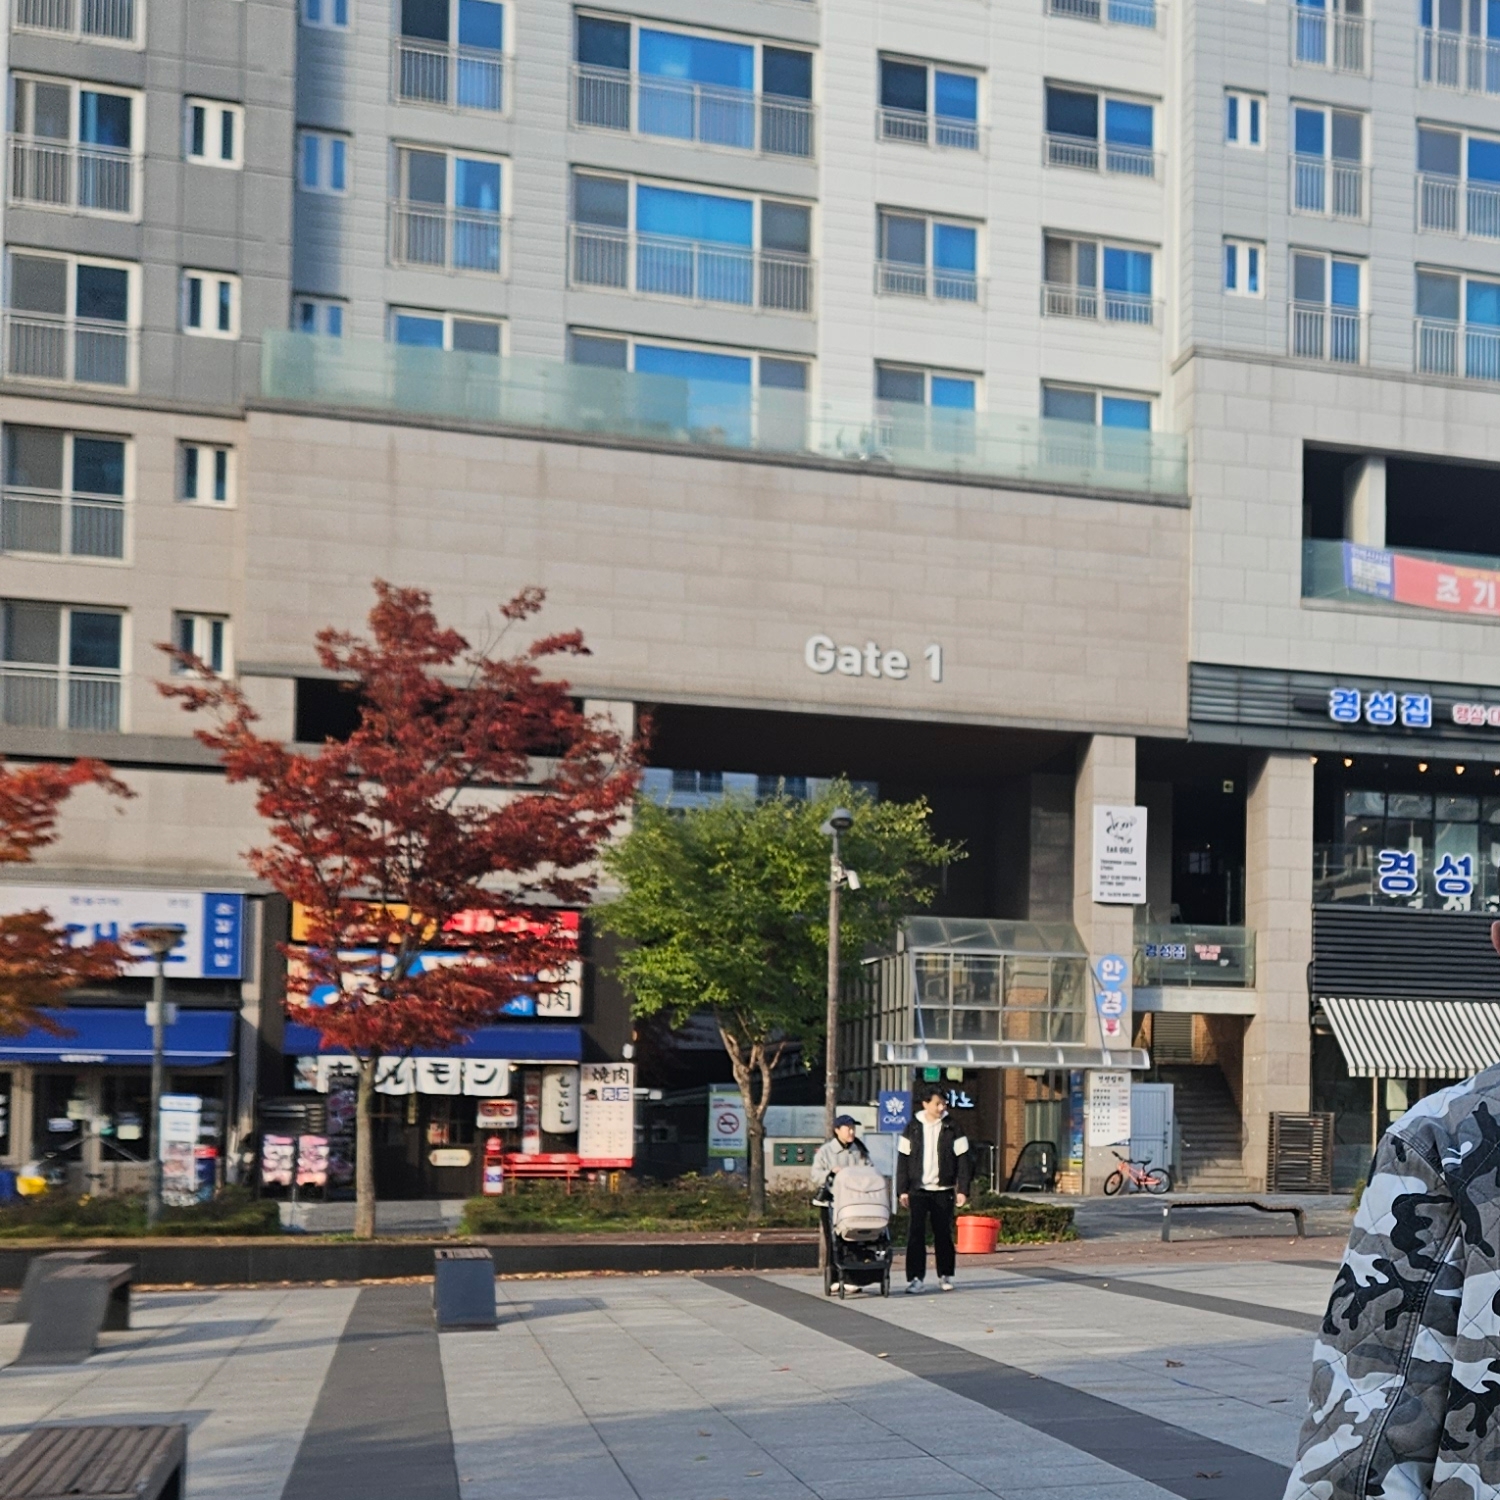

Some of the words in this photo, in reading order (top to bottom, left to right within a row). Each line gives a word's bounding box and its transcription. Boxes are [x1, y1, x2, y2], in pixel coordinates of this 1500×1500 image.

[804, 633, 910, 680] Gate
[924, 643, 943, 682] 1
[1329, 688, 1432, 728] 경성집
[1101, 958, 1124, 1014] 안경
